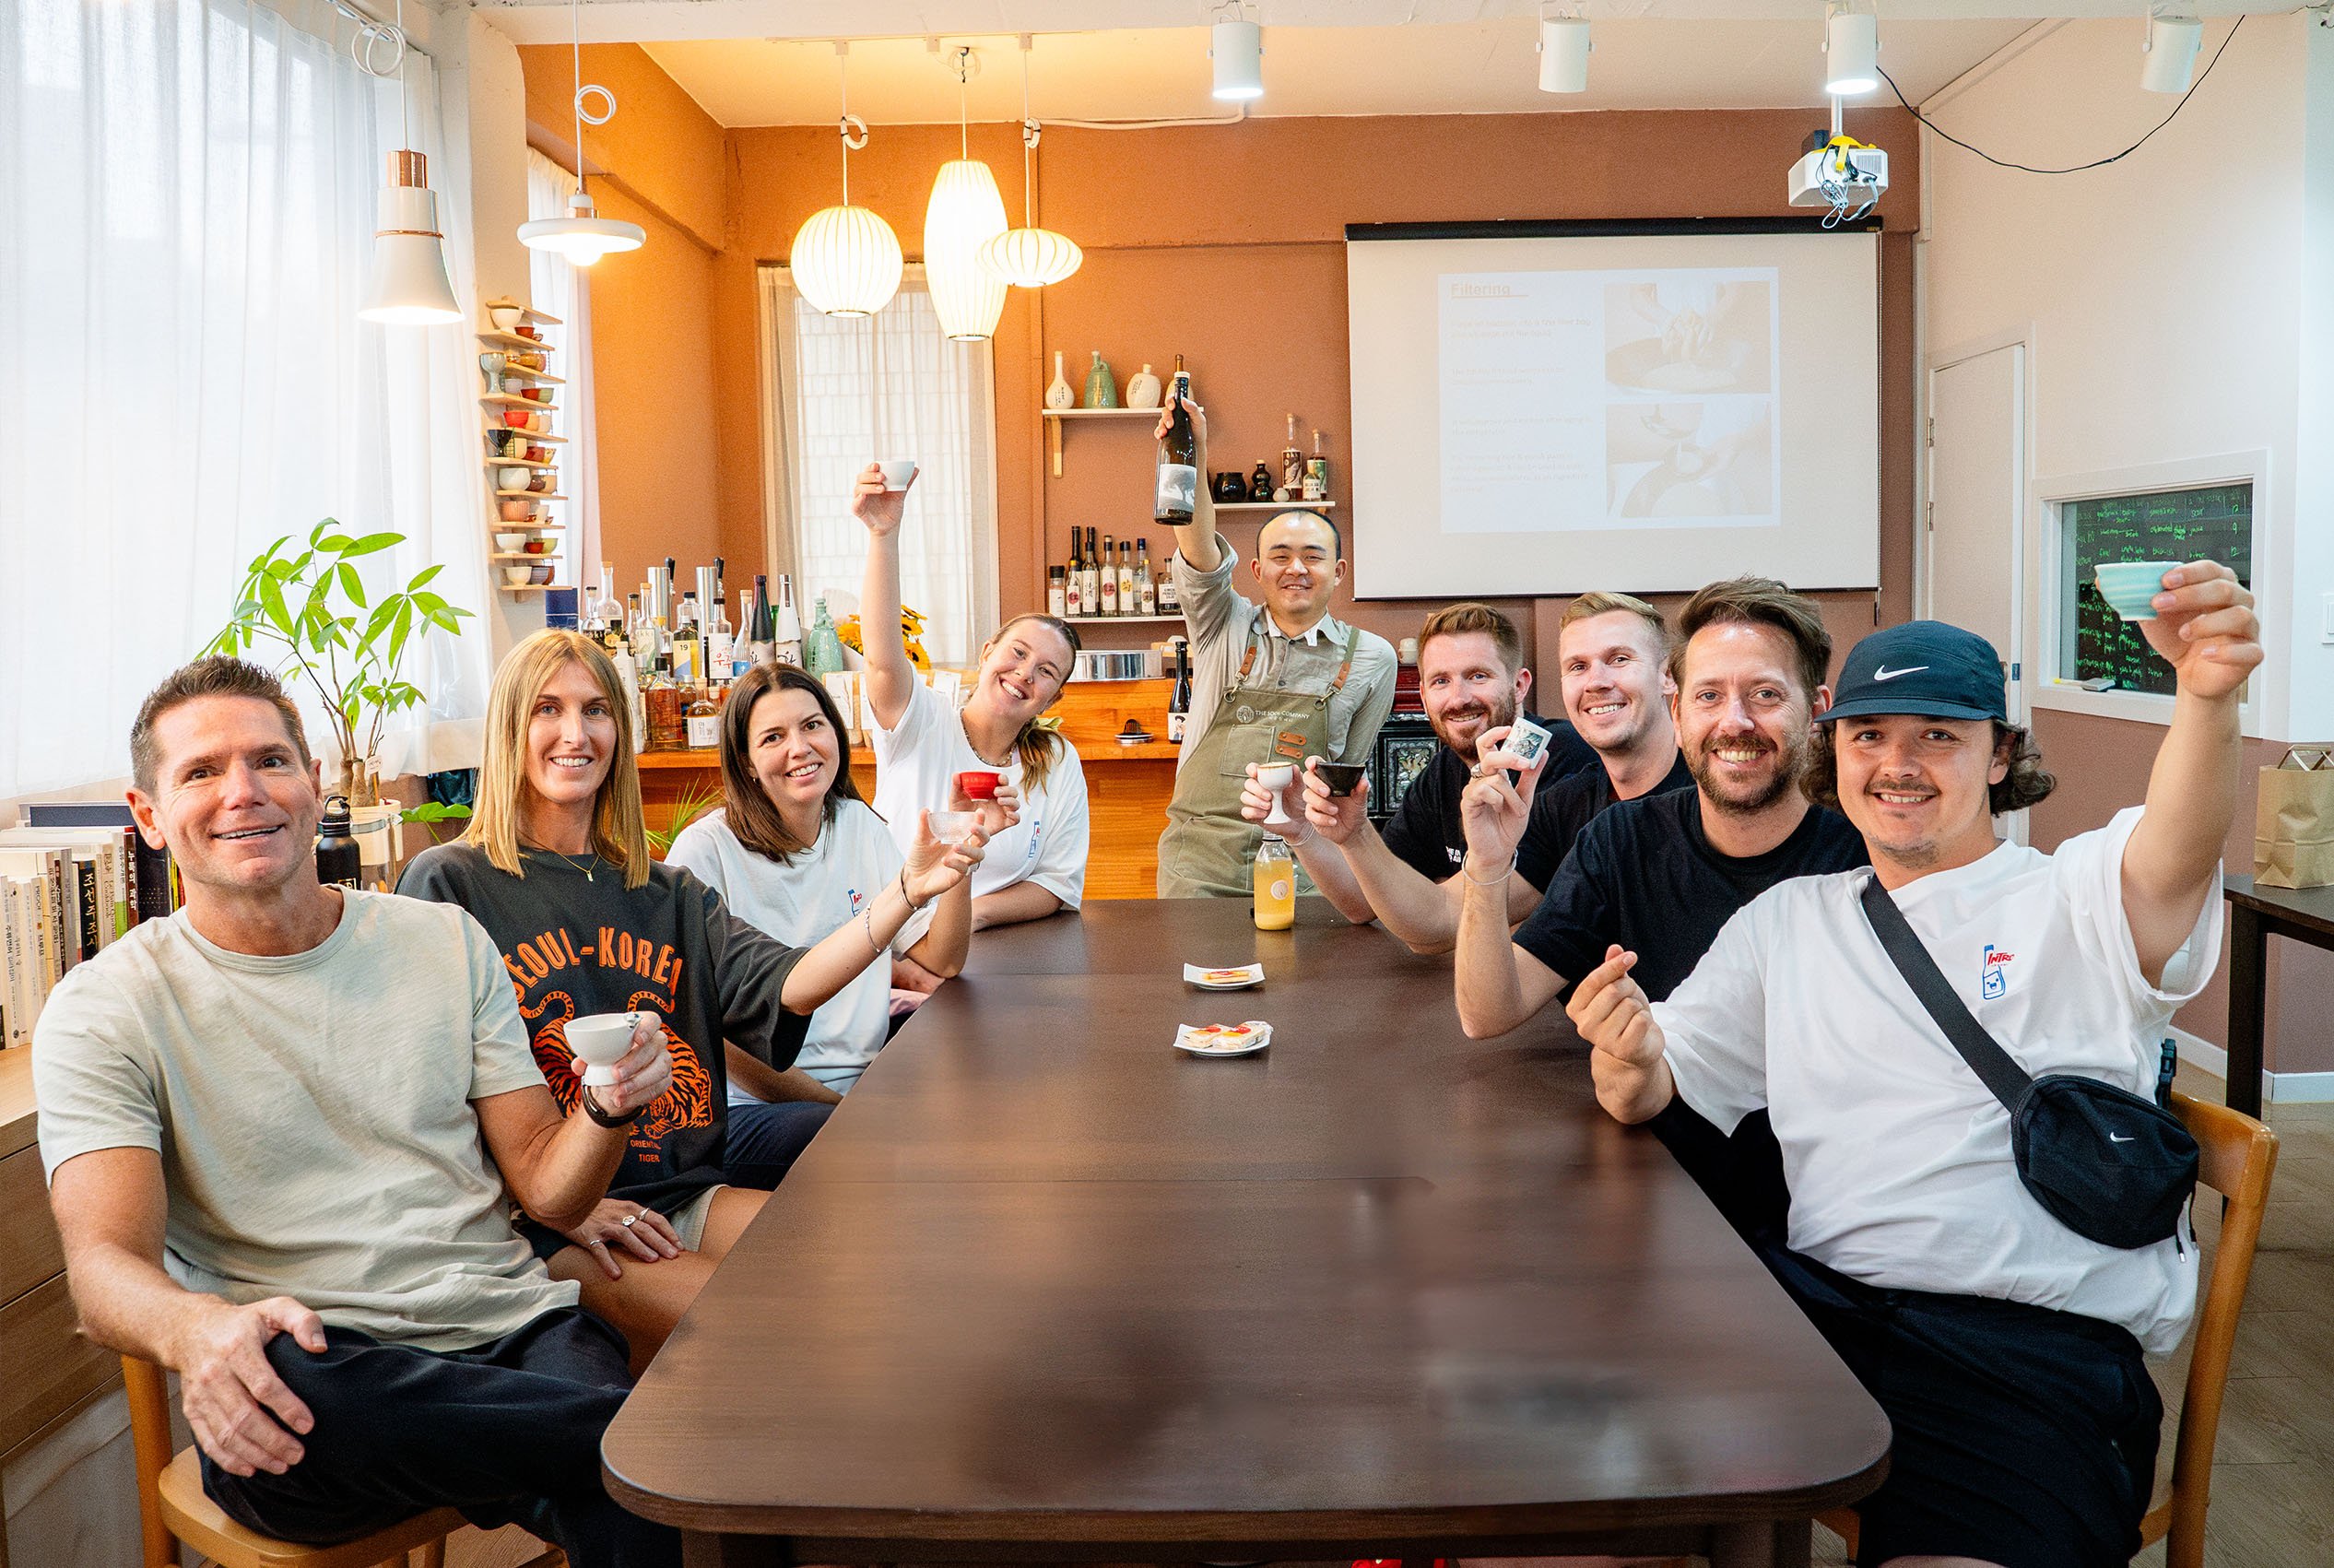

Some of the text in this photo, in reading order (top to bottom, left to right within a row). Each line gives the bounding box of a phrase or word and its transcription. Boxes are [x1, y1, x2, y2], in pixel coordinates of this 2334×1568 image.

[1451, 283, 1511, 297] Filtering
[1281, 710, 1310, 720] COMPANY
[639, 1153, 660, 1163] TIGER
